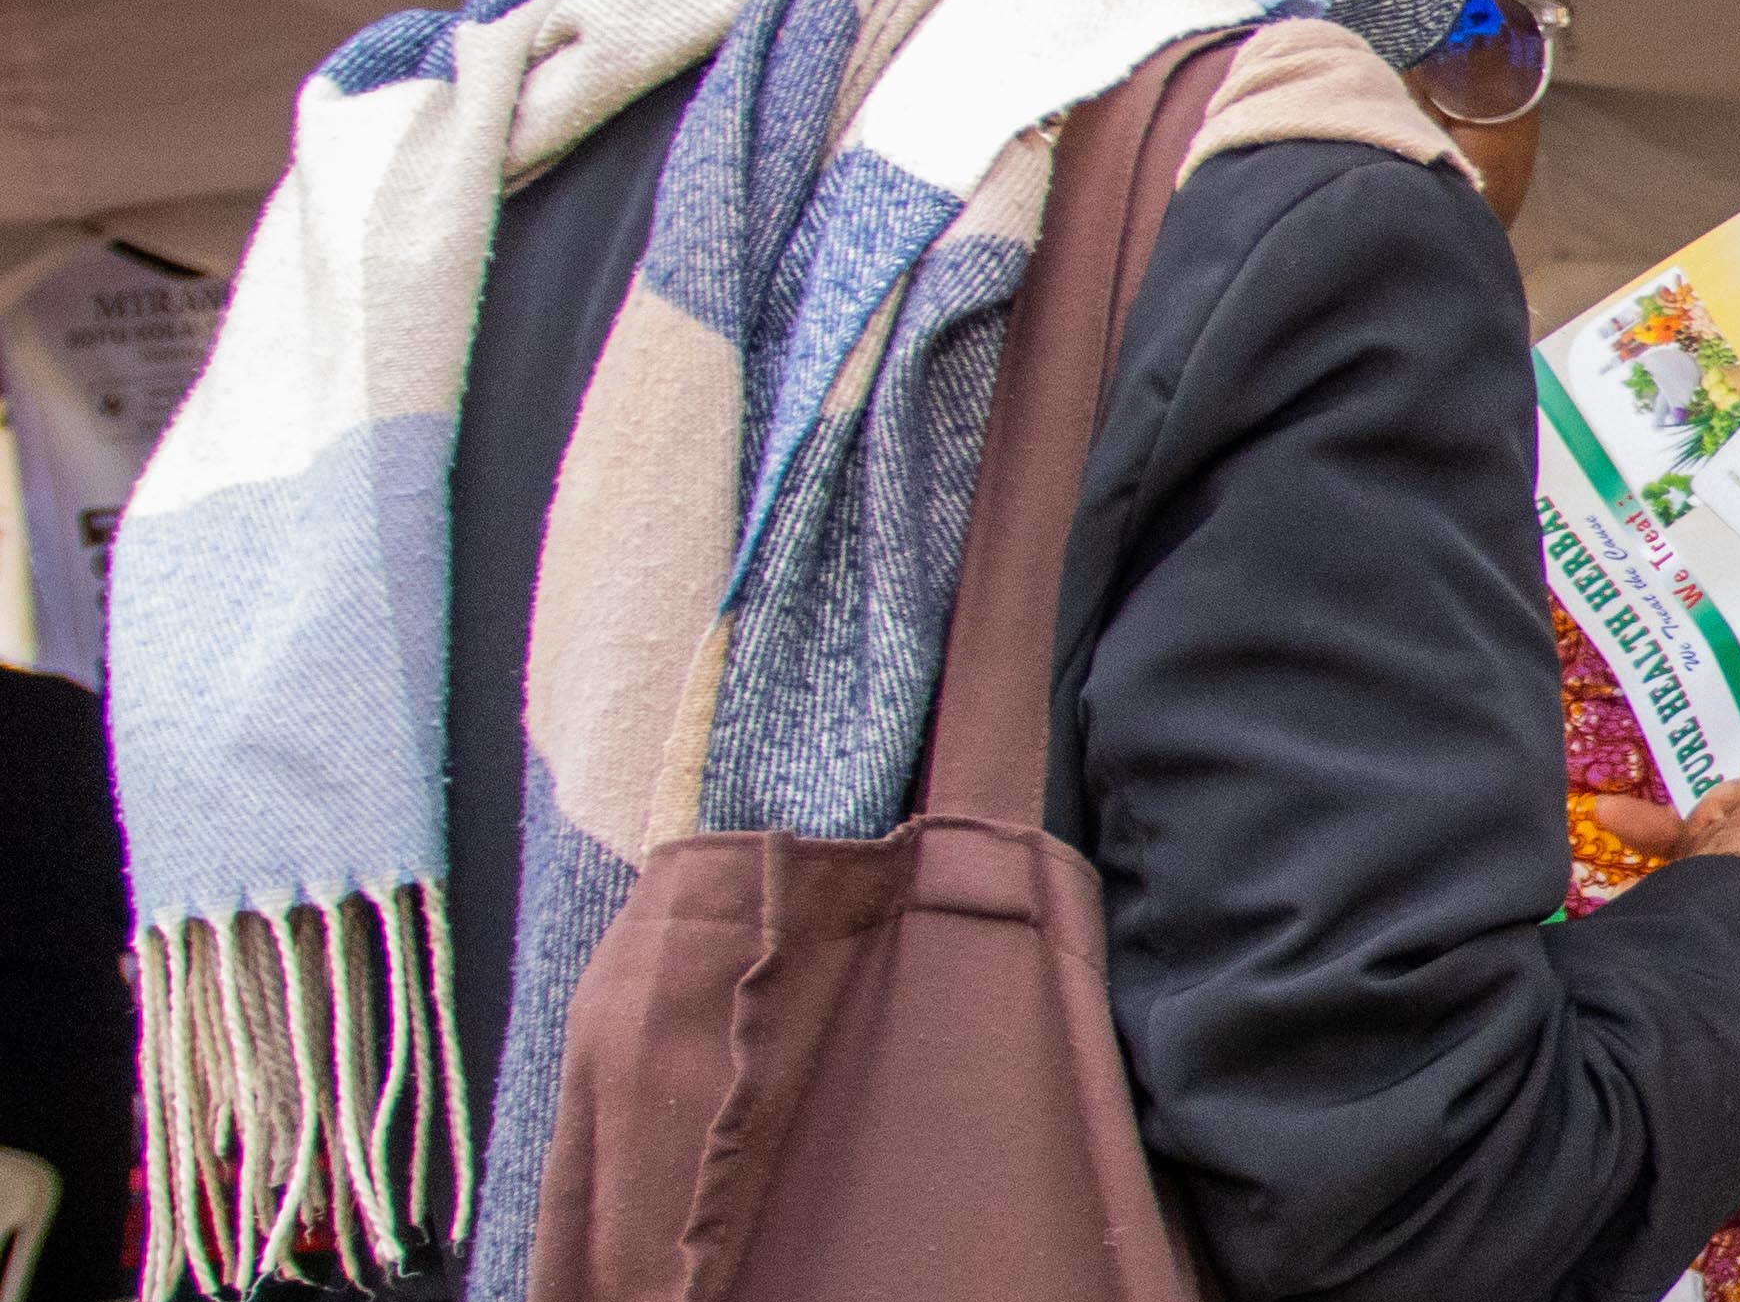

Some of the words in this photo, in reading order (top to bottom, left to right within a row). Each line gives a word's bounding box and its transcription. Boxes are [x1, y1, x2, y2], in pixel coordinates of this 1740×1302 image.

[1585, 514, 1628, 560] Cause
[1623, 509, 1673, 570] Treat
[1625, 566, 1647, 590] the
[1672, 568, 1708, 611] We
[1641, 594, 1679, 640] Treat
[1603, 603, 1690, 724] HEALTH
[1679, 642, 1700, 671] We
[1667, 715, 1724, 799] PURE
